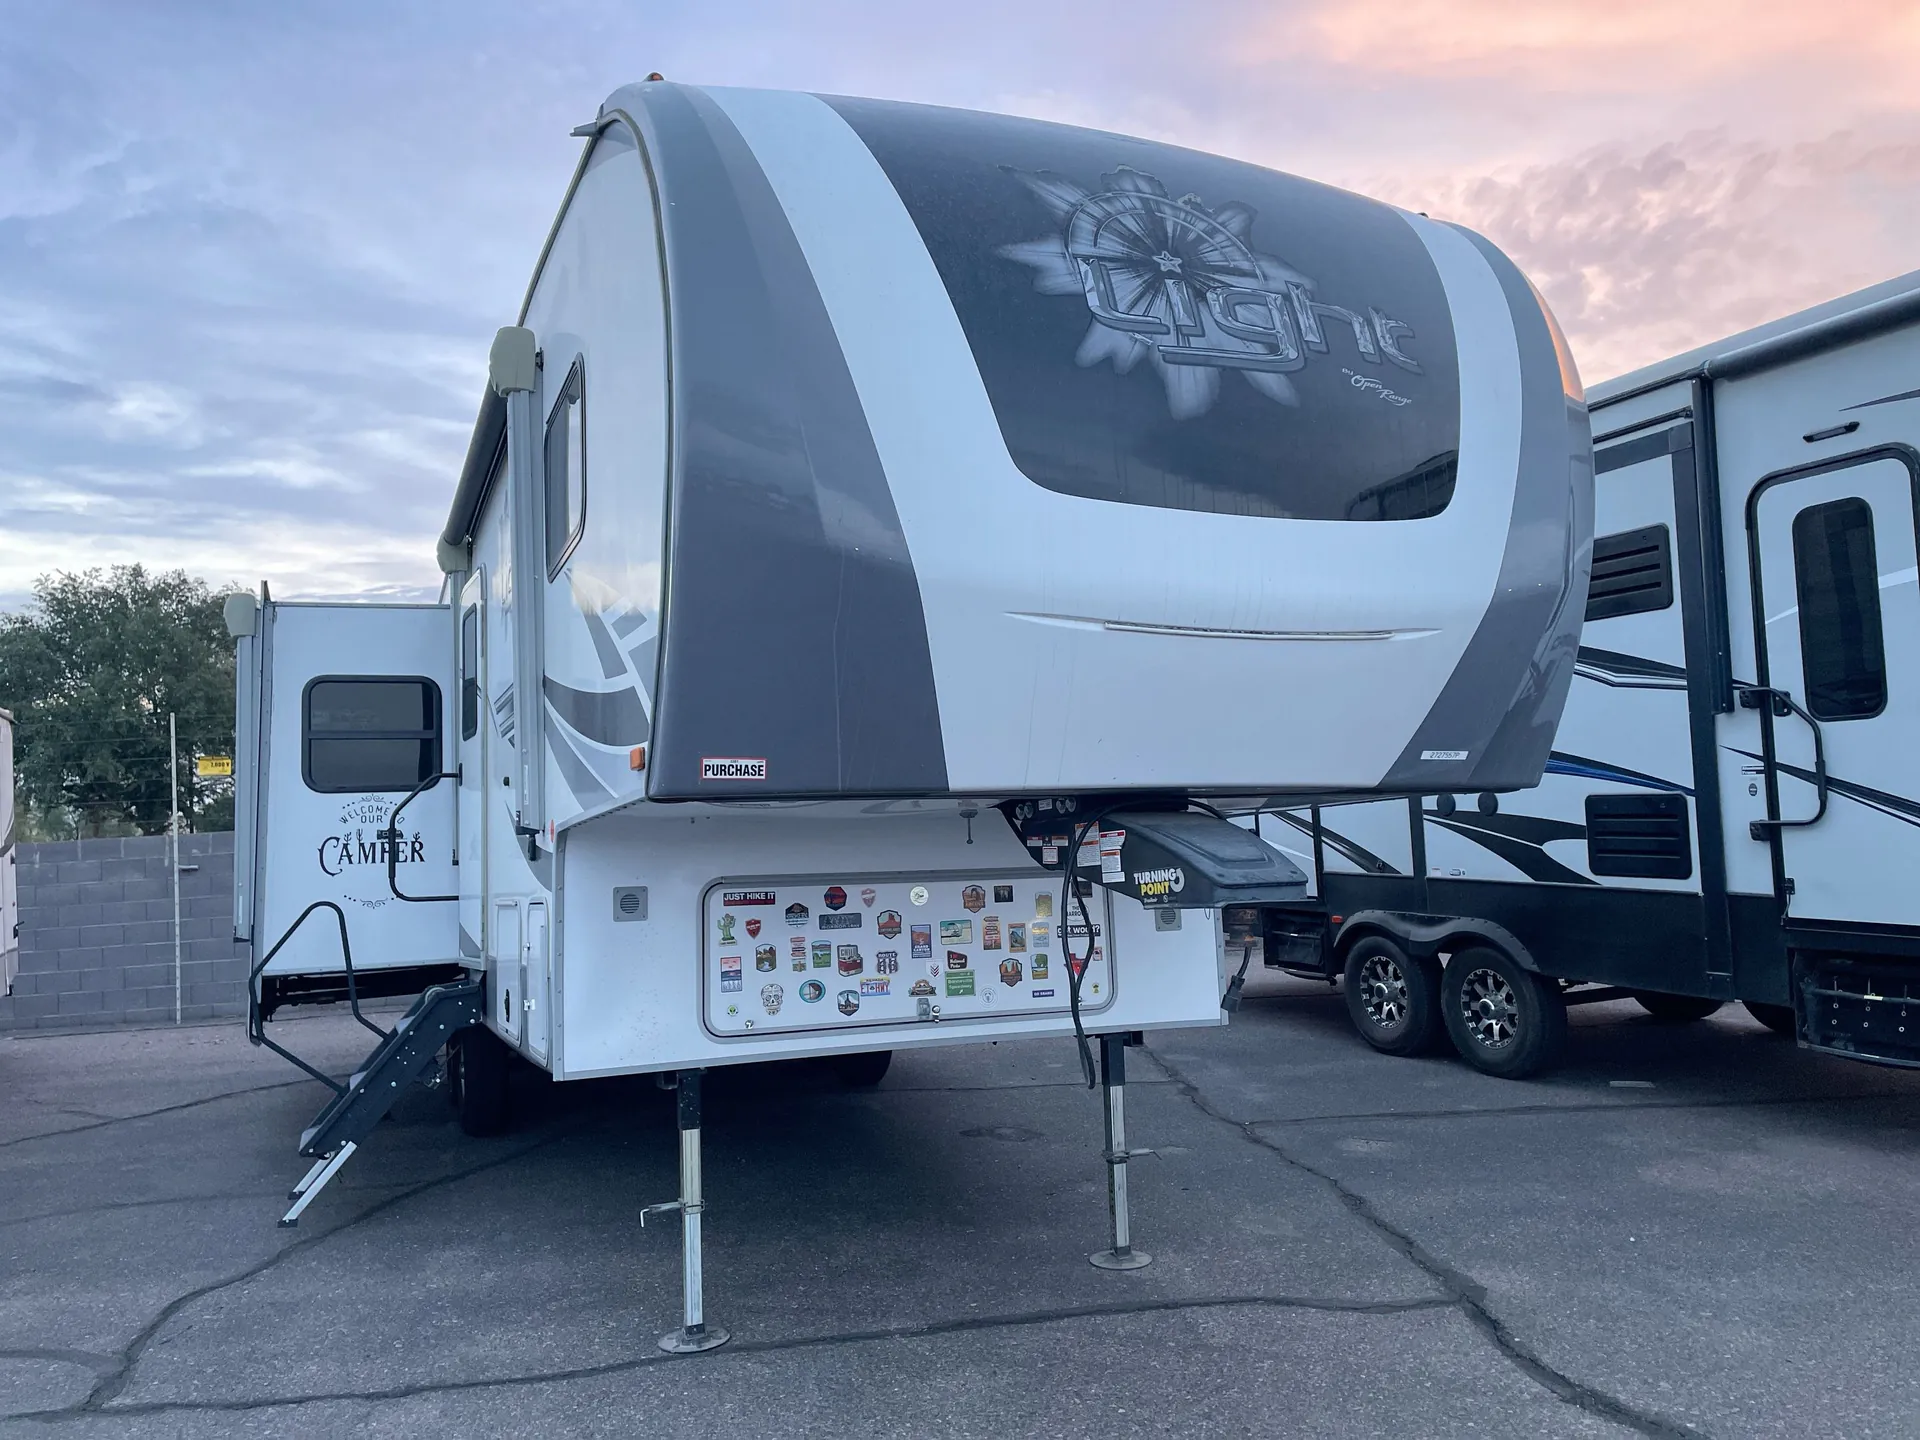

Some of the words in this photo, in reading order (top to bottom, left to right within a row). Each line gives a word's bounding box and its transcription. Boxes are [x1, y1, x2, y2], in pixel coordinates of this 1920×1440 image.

[1351, 375, 1382, 390] Open
[1375, 389, 1412, 406] Range
[704, 764, 764, 776] PURCHASE
[338, 804, 390, 824] WELCOME
[360, 815, 383, 824] OUR
[1133, 868, 1177, 885] TURNING
[1141, 881, 1169, 896] POINT
[724, 893, 745, 901] JUST
[746, 892, 766, 900] HIKE
